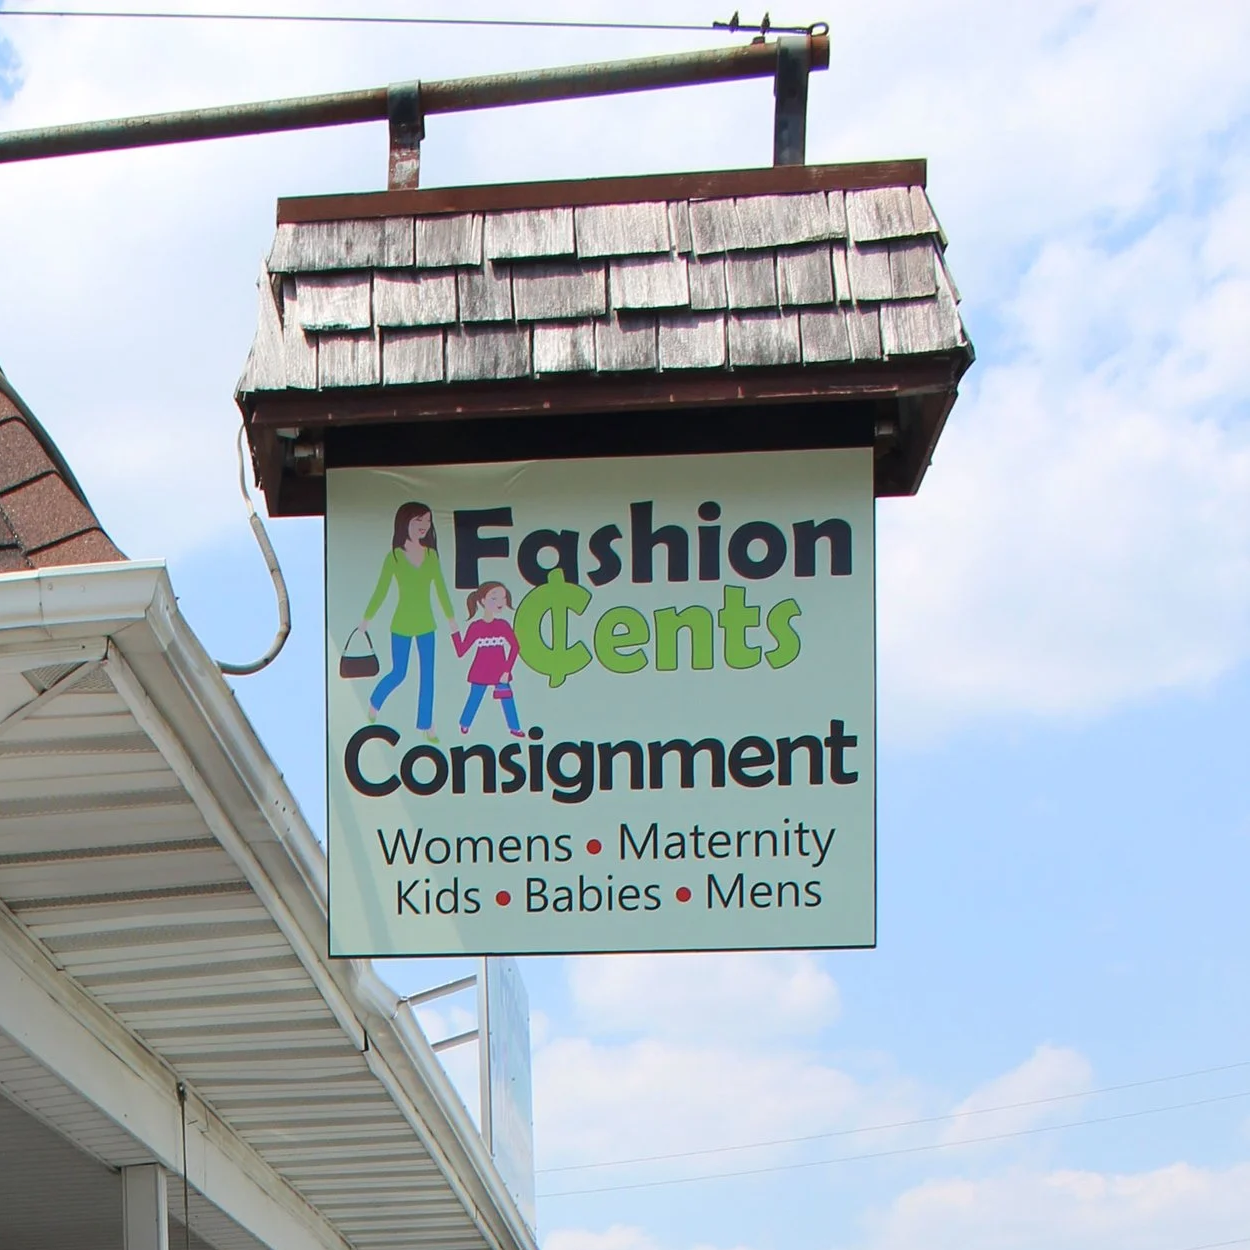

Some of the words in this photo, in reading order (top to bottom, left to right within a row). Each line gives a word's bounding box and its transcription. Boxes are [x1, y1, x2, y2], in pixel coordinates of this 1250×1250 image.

[453, 500, 852, 590] Fashion
[344, 719, 858, 803] Consignment
[376, 827, 573, 866] Womens
[618, 818, 837, 867] Maternity
[395, 877, 481, 916] Kids
[525, 874, 663, 913] Babies
[706, 872, 823, 909] Mens
